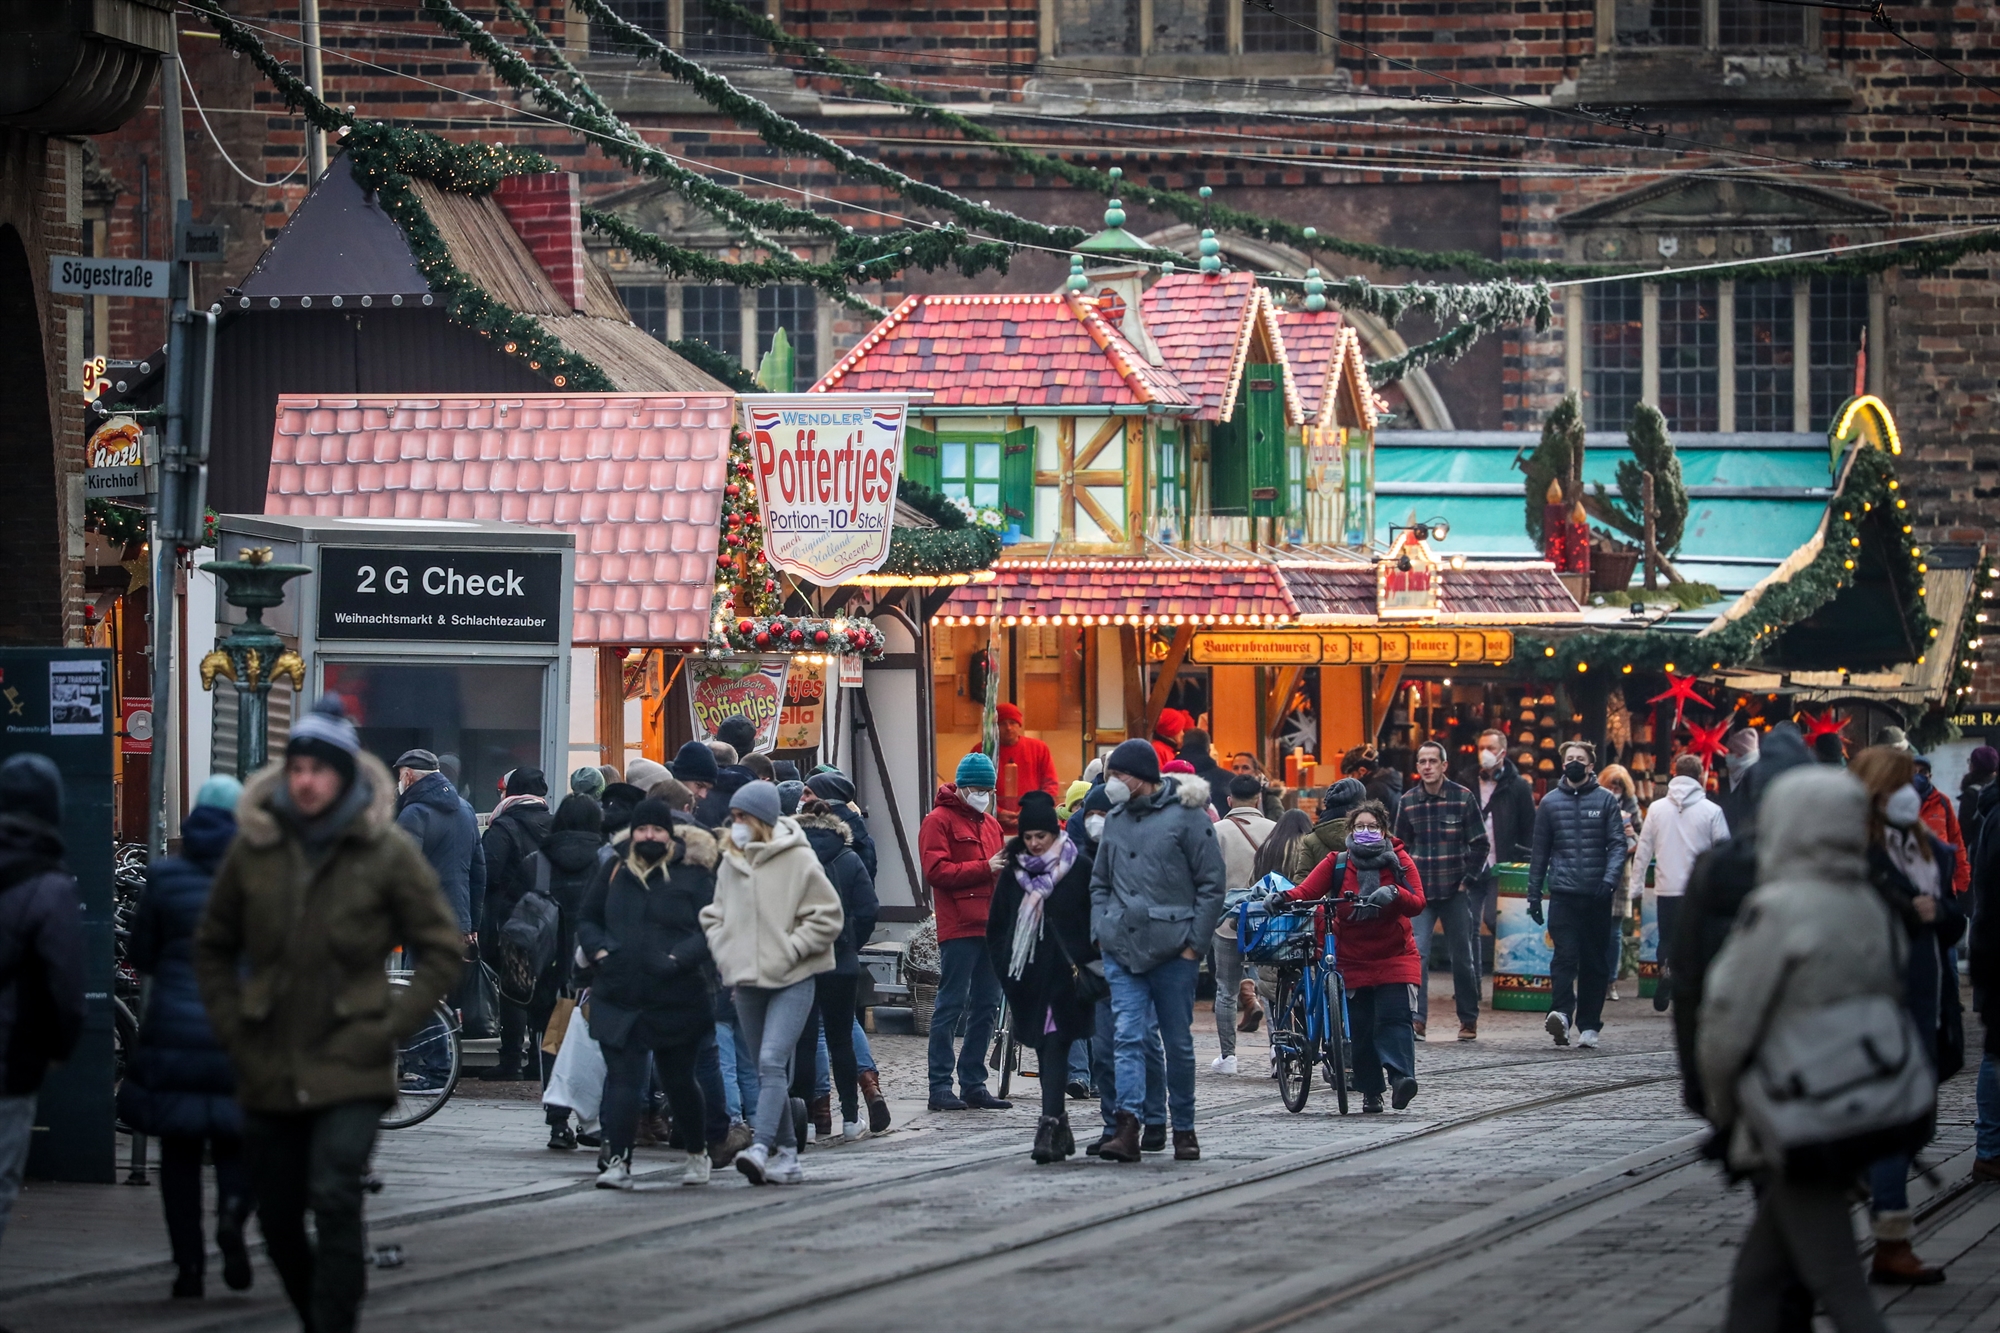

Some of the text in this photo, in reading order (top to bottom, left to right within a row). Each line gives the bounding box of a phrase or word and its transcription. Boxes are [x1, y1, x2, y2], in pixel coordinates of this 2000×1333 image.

[62, 261, 153, 289] Sögestraße
[94, 433, 143, 468] Brezel
[754, 429, 895, 523] Poffertjes
[790, 526, 831, 560] Original
[808, 533, 855, 566] Holland-
[833, 533, 874, 566] Rezept!
[356, 565, 525, 597] 2 G Check
[335, 612, 547, 627] Weihnachtsmarkt & Schlachtezauber
[1203, 640, 1311, 653] Bauernbratwurst
[701, 680, 767, 703] Holländische
[693, 691, 777, 730] Poffertjes
[6, 725, 51, 734] Obernstraß
